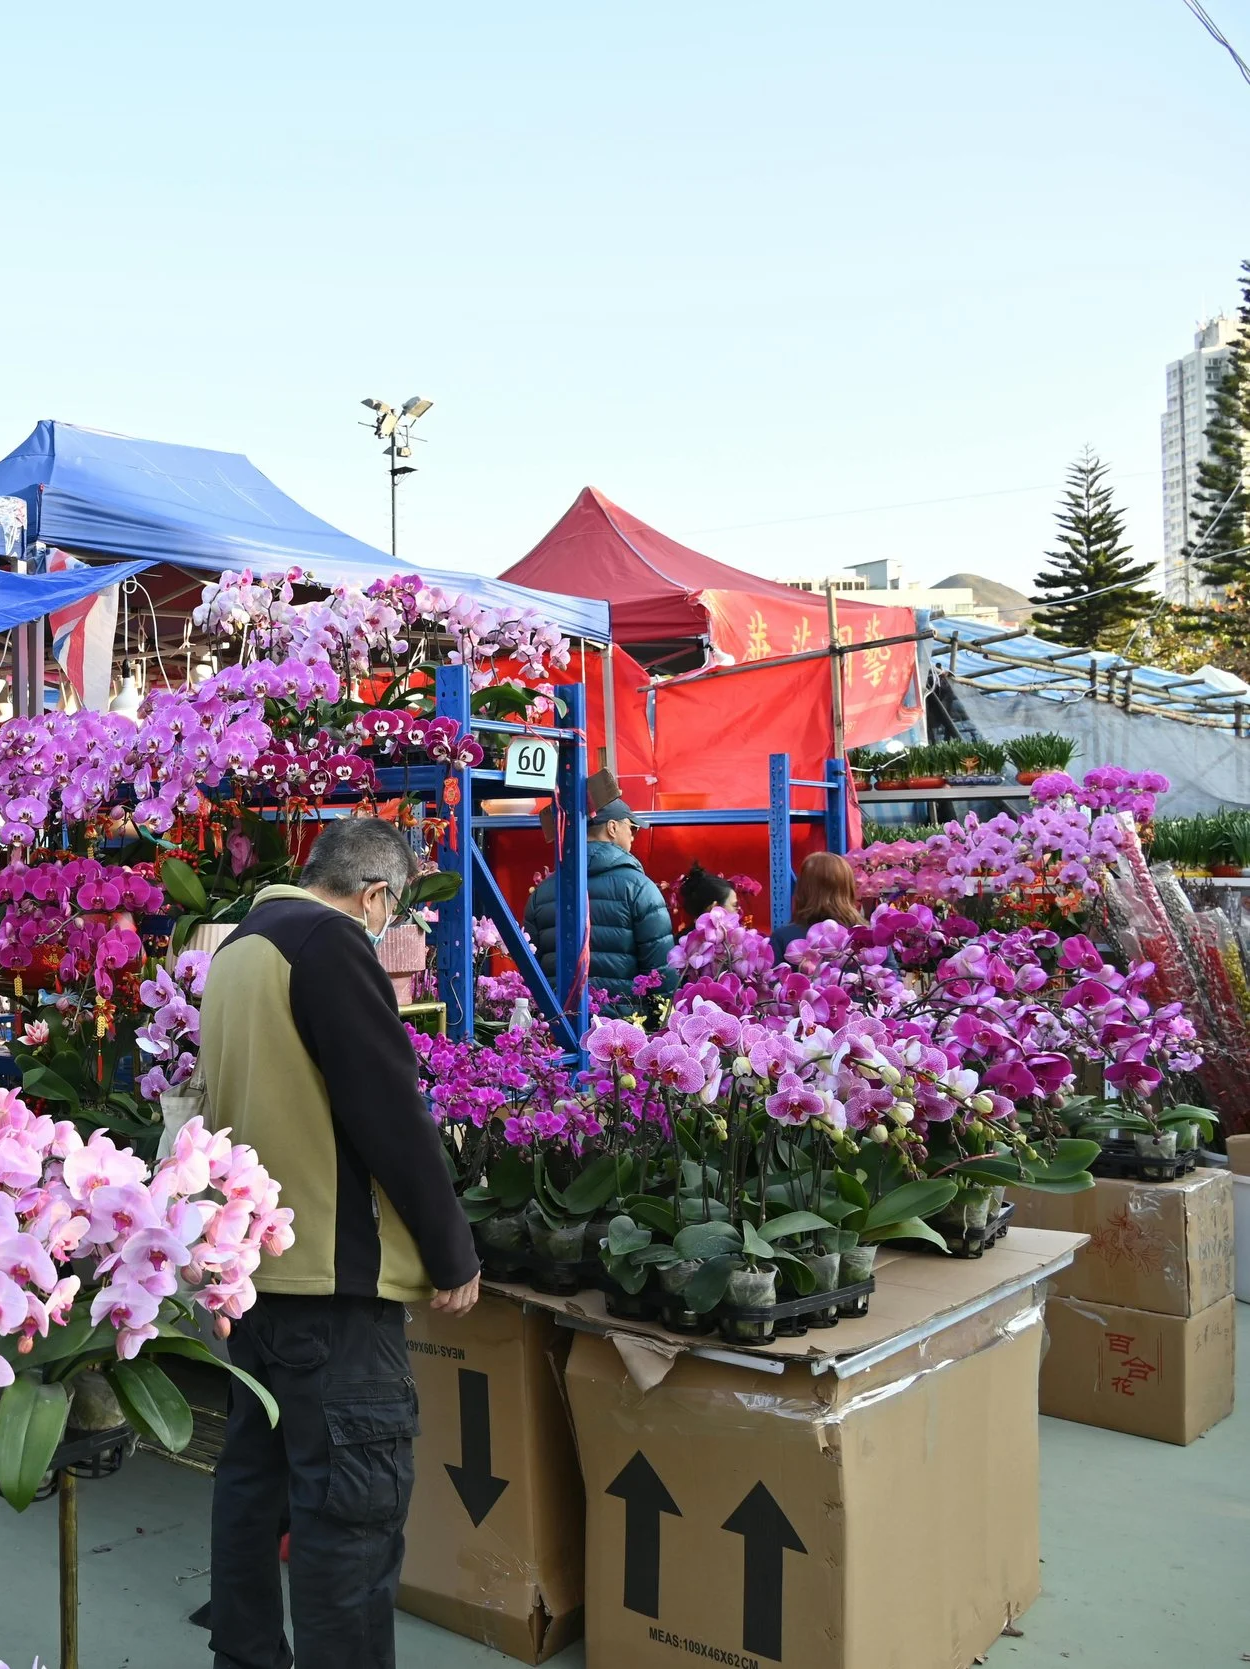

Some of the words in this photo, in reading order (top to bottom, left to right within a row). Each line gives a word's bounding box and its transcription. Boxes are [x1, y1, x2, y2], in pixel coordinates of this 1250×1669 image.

[518, 746, 546, 772] 60
[1104, 1332, 1156, 1396] 百合花
